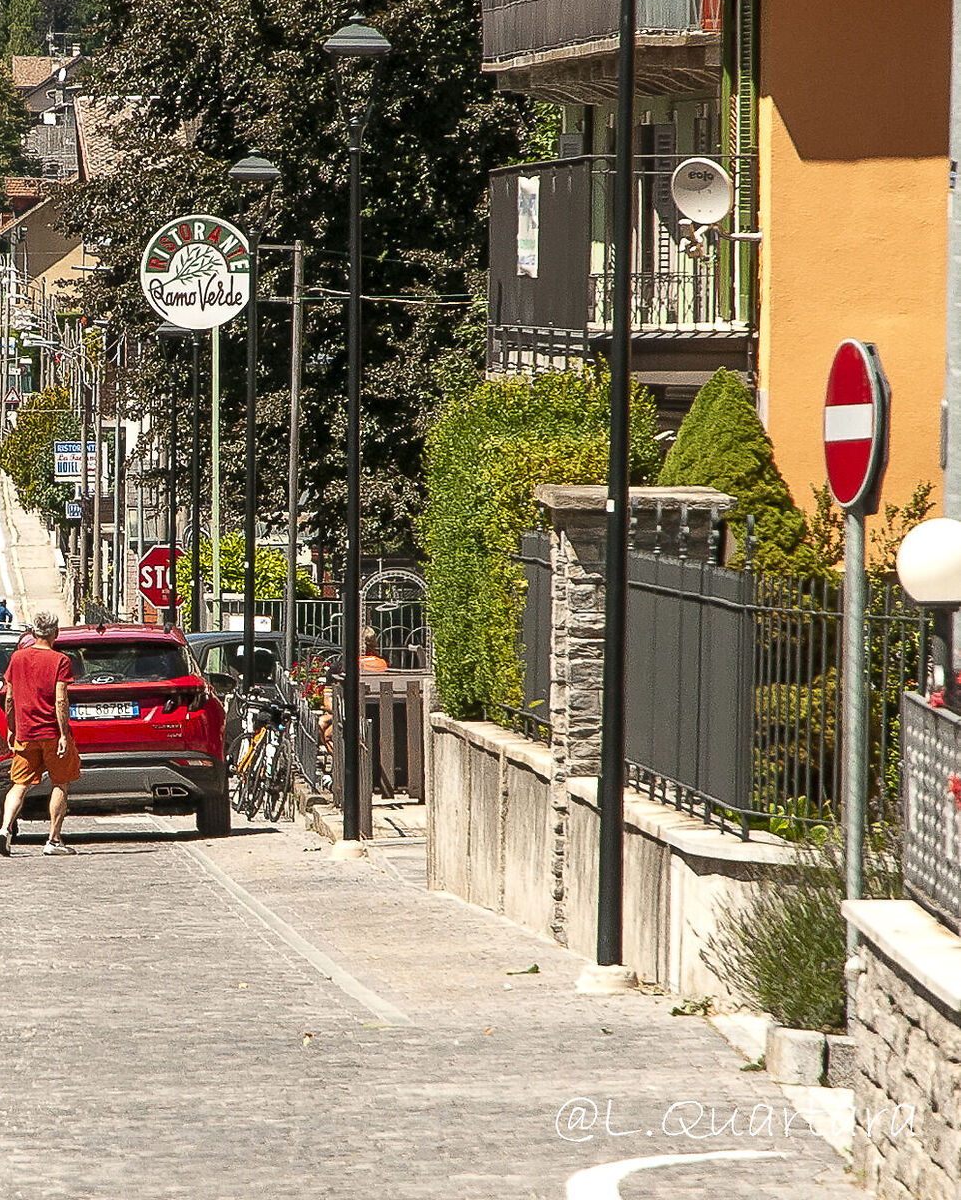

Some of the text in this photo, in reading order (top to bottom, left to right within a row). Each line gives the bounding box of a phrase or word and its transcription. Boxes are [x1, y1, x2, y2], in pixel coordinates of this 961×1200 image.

[148, 221, 250, 272] RISTORANTE
[148, 273, 243, 316] Ramo Verde
[57, 461, 79, 473] HOTEL
